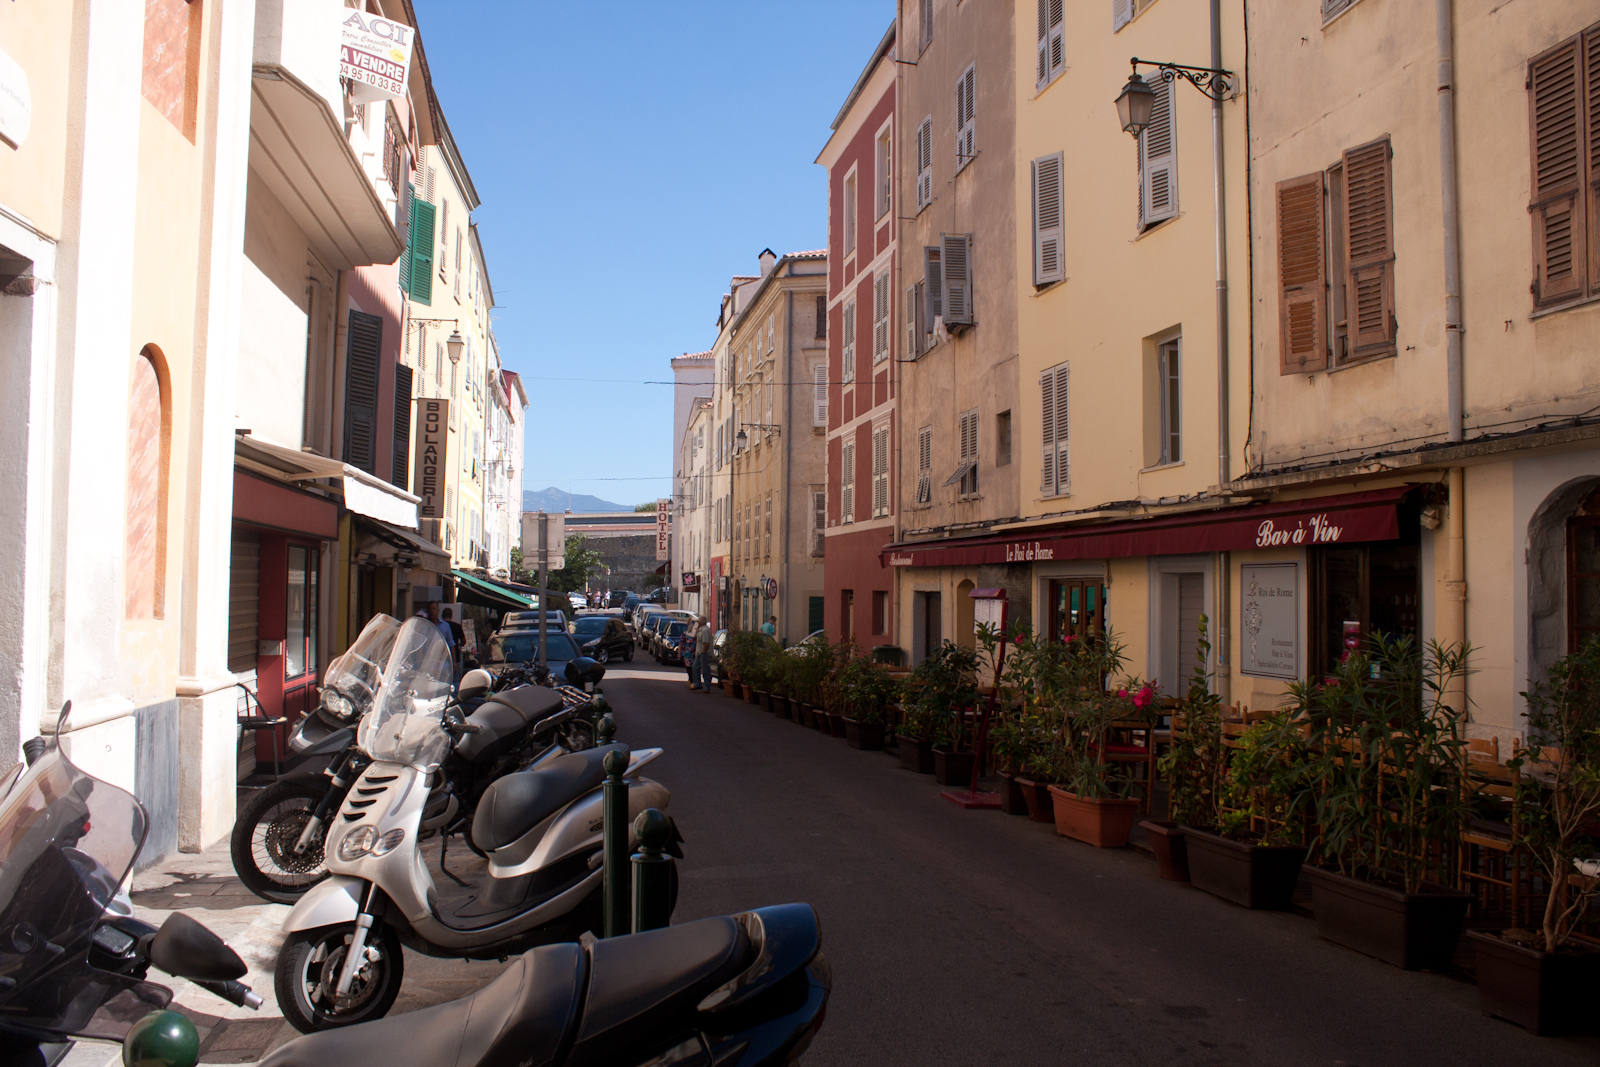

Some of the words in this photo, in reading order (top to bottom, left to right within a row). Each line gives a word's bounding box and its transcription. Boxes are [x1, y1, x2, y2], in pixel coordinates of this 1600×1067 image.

[342, 30, 359, 40] Votre
[360, 35, 392, 49] Conseiller
[343, 12, 408, 46] ACI
[350, 41, 383, 53] immobilier
[340, 46, 350, 62] A
[352, 50, 404, 82] VENDRE
[351, 68, 363, 80] 95
[366, 72, 376, 85] 10
[378, 77, 389, 90] 33
[391, 82, 402, 95] 83
[421, 401, 440, 516] BOULANGERIE
[658, 502, 668, 551] HOTEL
[1255, 519, 1293, 547] Bar
[1292, 520, 1307, 544] à
[1308, 513, 1344, 543] Vin
[1006, 544, 1014, 562] Le
[1013, 543, 1025, 561] Roi
[1025, 542, 1034, 561] de
[1034, 541, 1054, 560] Rome
[1258, 587, 1268, 597] Roi
[1269, 587, 1276, 597] de
[1276, 587, 1294, 597] Rome
[1271, 638, 1293, 647] Restaurant
[1271, 649, 1280, 658] Bar
[1284, 650, 1293, 659] Vins
[1279, 661, 1293, 671] Corses
